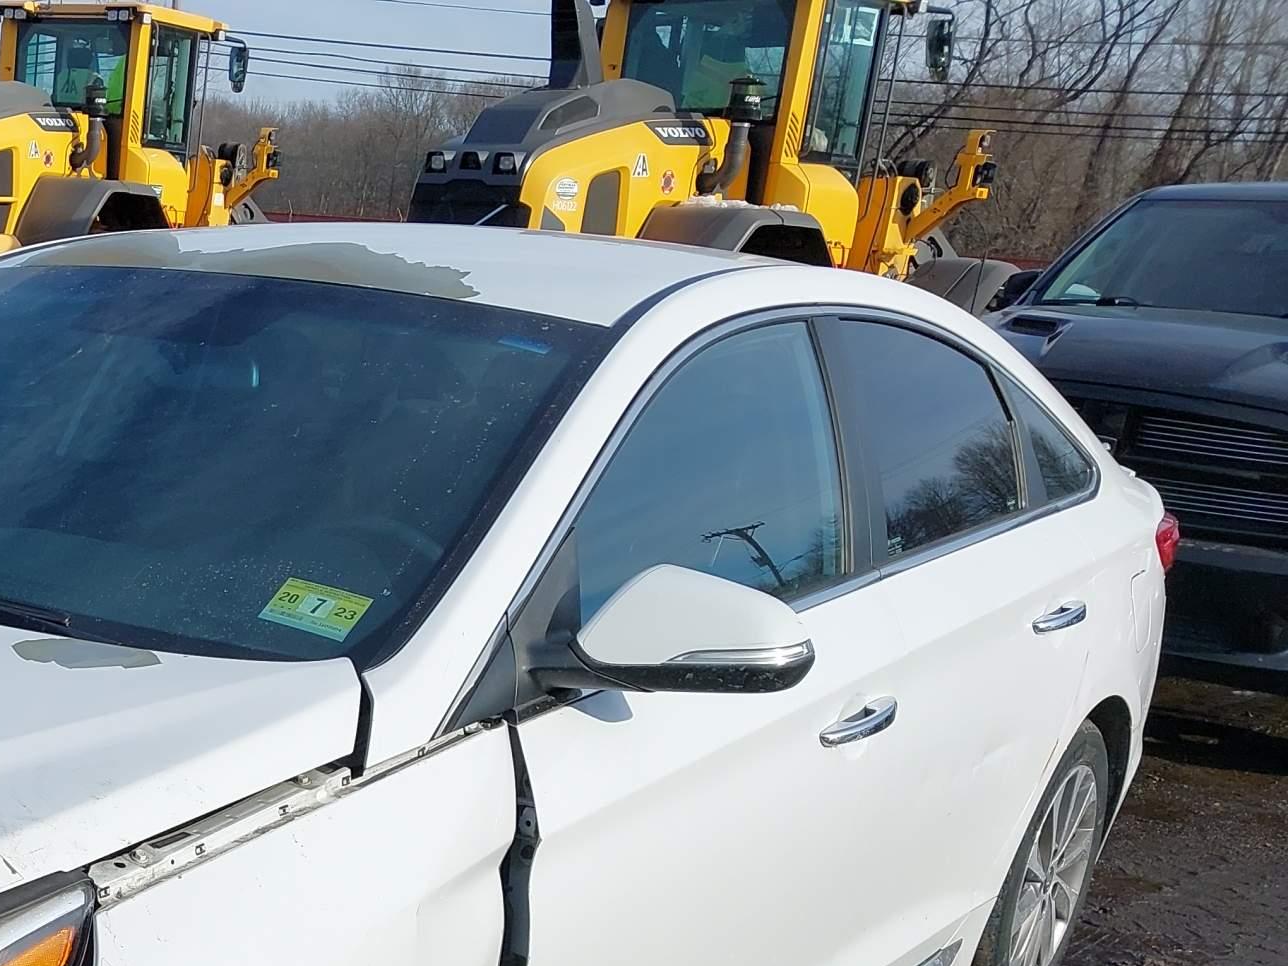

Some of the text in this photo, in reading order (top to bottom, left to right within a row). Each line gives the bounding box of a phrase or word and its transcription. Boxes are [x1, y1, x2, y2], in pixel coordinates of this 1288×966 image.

[35, 117, 74, 127] VOLVO
[654, 126, 707, 138] VOLVO
[278, 591, 300, 604] 20
[309, 597, 328, 615] 7
[333, 606, 357, 621] 23
